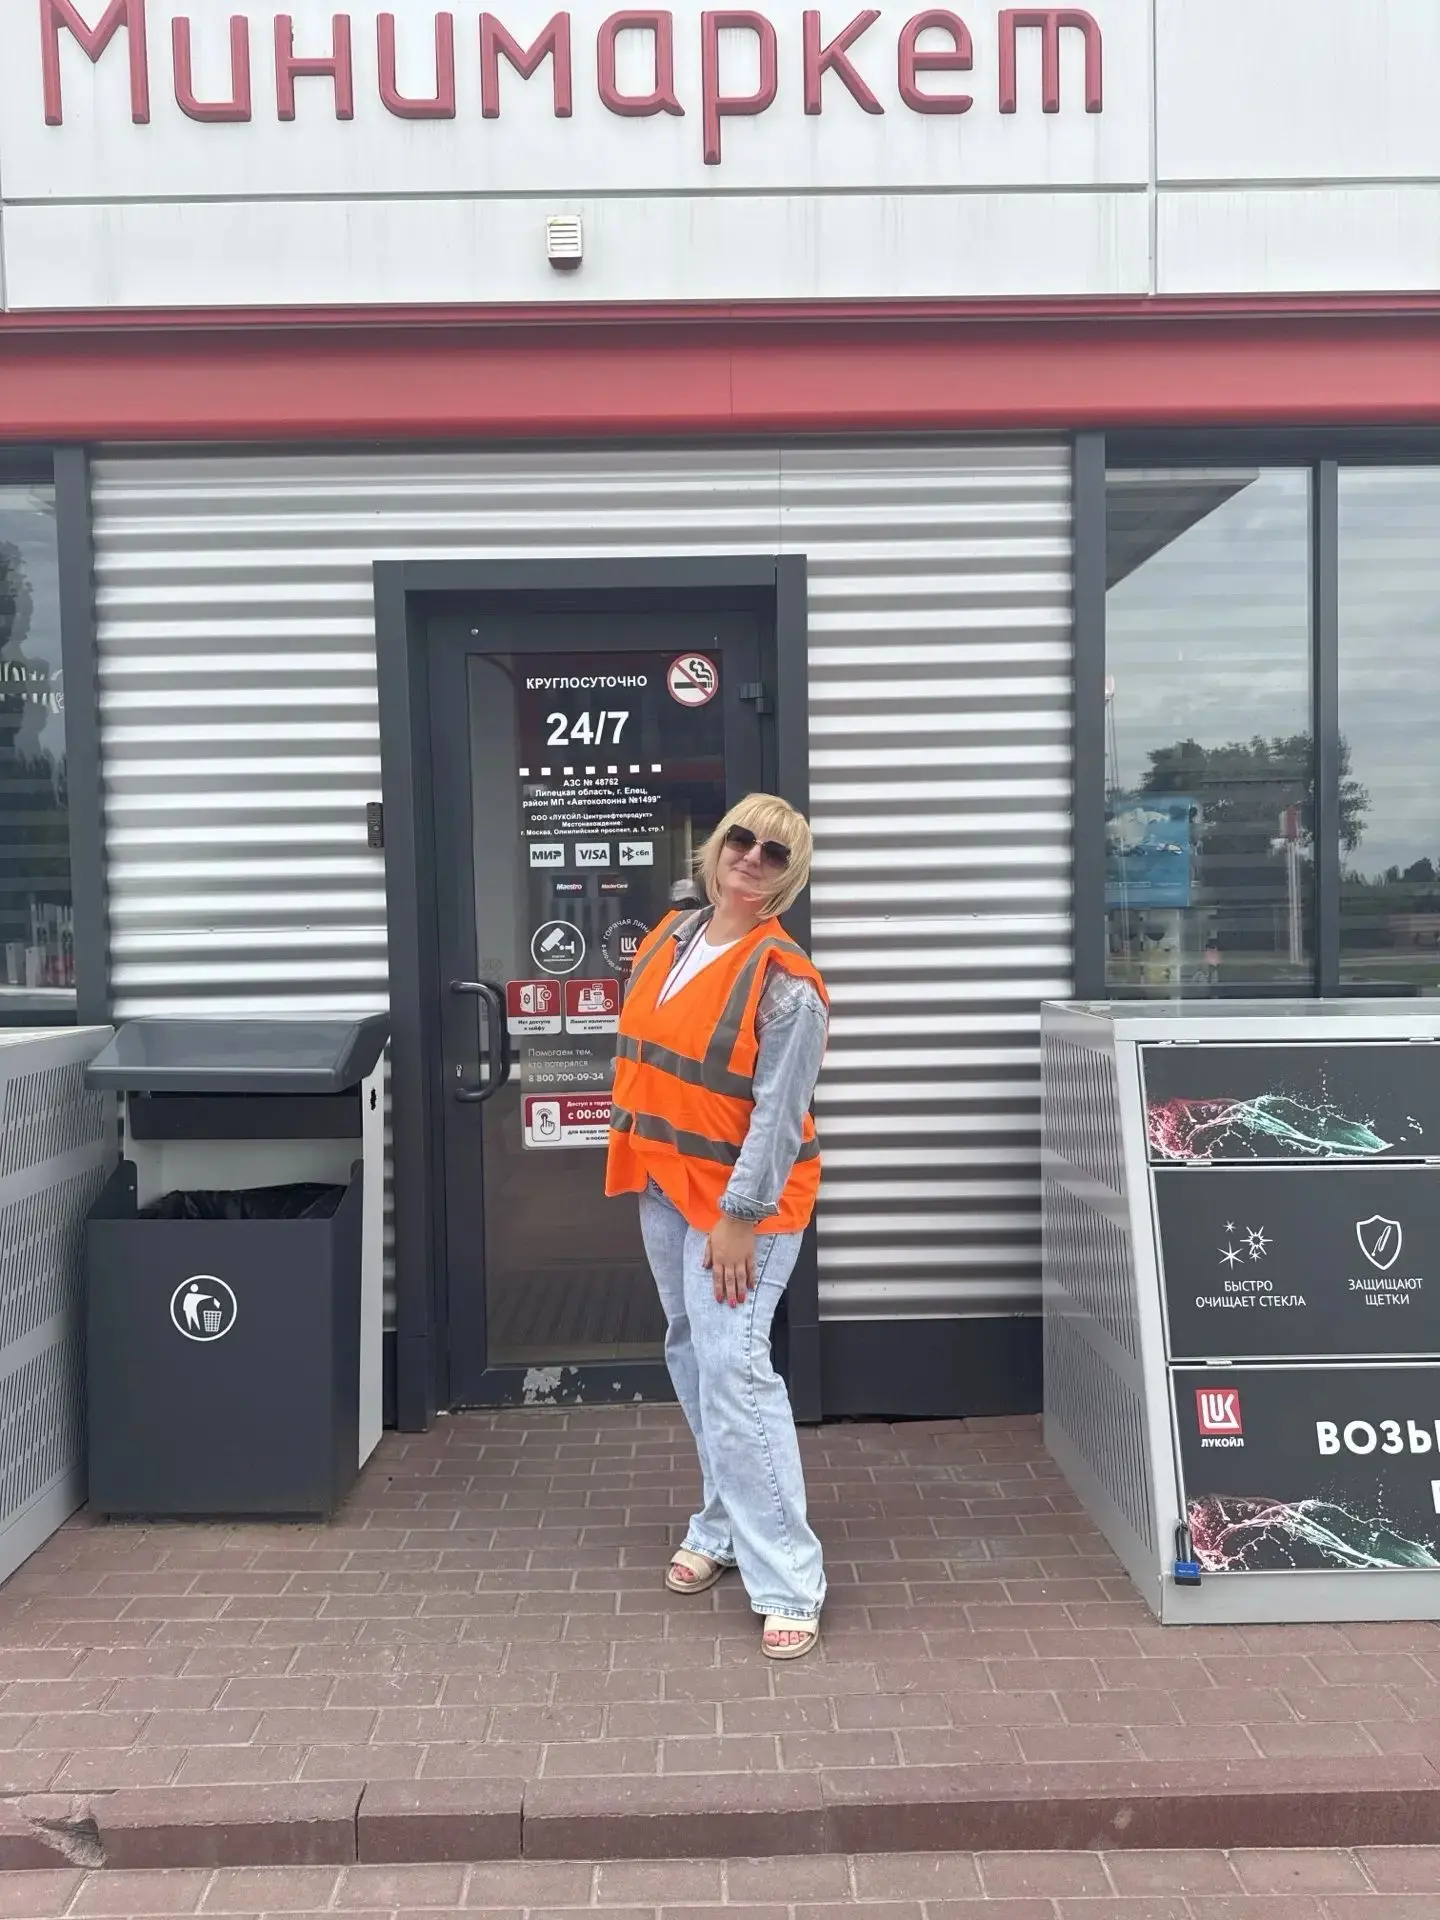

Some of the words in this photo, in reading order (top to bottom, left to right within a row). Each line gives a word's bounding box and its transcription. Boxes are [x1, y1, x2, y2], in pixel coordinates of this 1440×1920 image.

[41, 0, 1103, 165] Минимаркет
[526, 675, 648, 690] КРУГЛОСУТОЧНО
[546, 710, 629, 746] 24/7
[563, 779, 581, 787] АЗС
[583, 778, 593, 786] №
[594, 778, 619, 786] 48762
[535, 789, 576, 797] Липецкая
[577, 788, 615, 796] область,
[624, 787, 648, 795] Елец,
[522, 799, 549, 808] район
[550, 798, 565, 806] МП
[567, 797, 627, 806] «Автоколонна
[532, 850, 562, 860] МИР
[580, 849, 608, 860] VISA
[635, 849, 650, 857] сбп
[603, 918, 632, 940] ГОРЯЧАЯ
[528, 1048, 574, 1057] Помогаем
[575, 1048, 594, 1056] тем,
[544, 1060, 588, 1069] потерялся
[536, 1073, 554, 1082] 800
[556, 1072, 604, 1081] 700-09-34
[567, 1112, 575, 1120] с
[576, 1109, 611, 1120] 00:00
[1224, 1280, 1273, 1292] БЫСТРО
[1348, 1278, 1423, 1291] ЗАЩИЩАЮТ
[1195, 1296, 1255, 1309] ОЧИЩАЕТ
[1258, 1295, 1306, 1308] СТЕКЛА
[1365, 1293, 1410, 1306] ЩЕТКИ
[1201, 1436, 1244, 1448] ЛУКОЙЛ
[1315, 1420, 1440, 1455] ВОЗЬ
